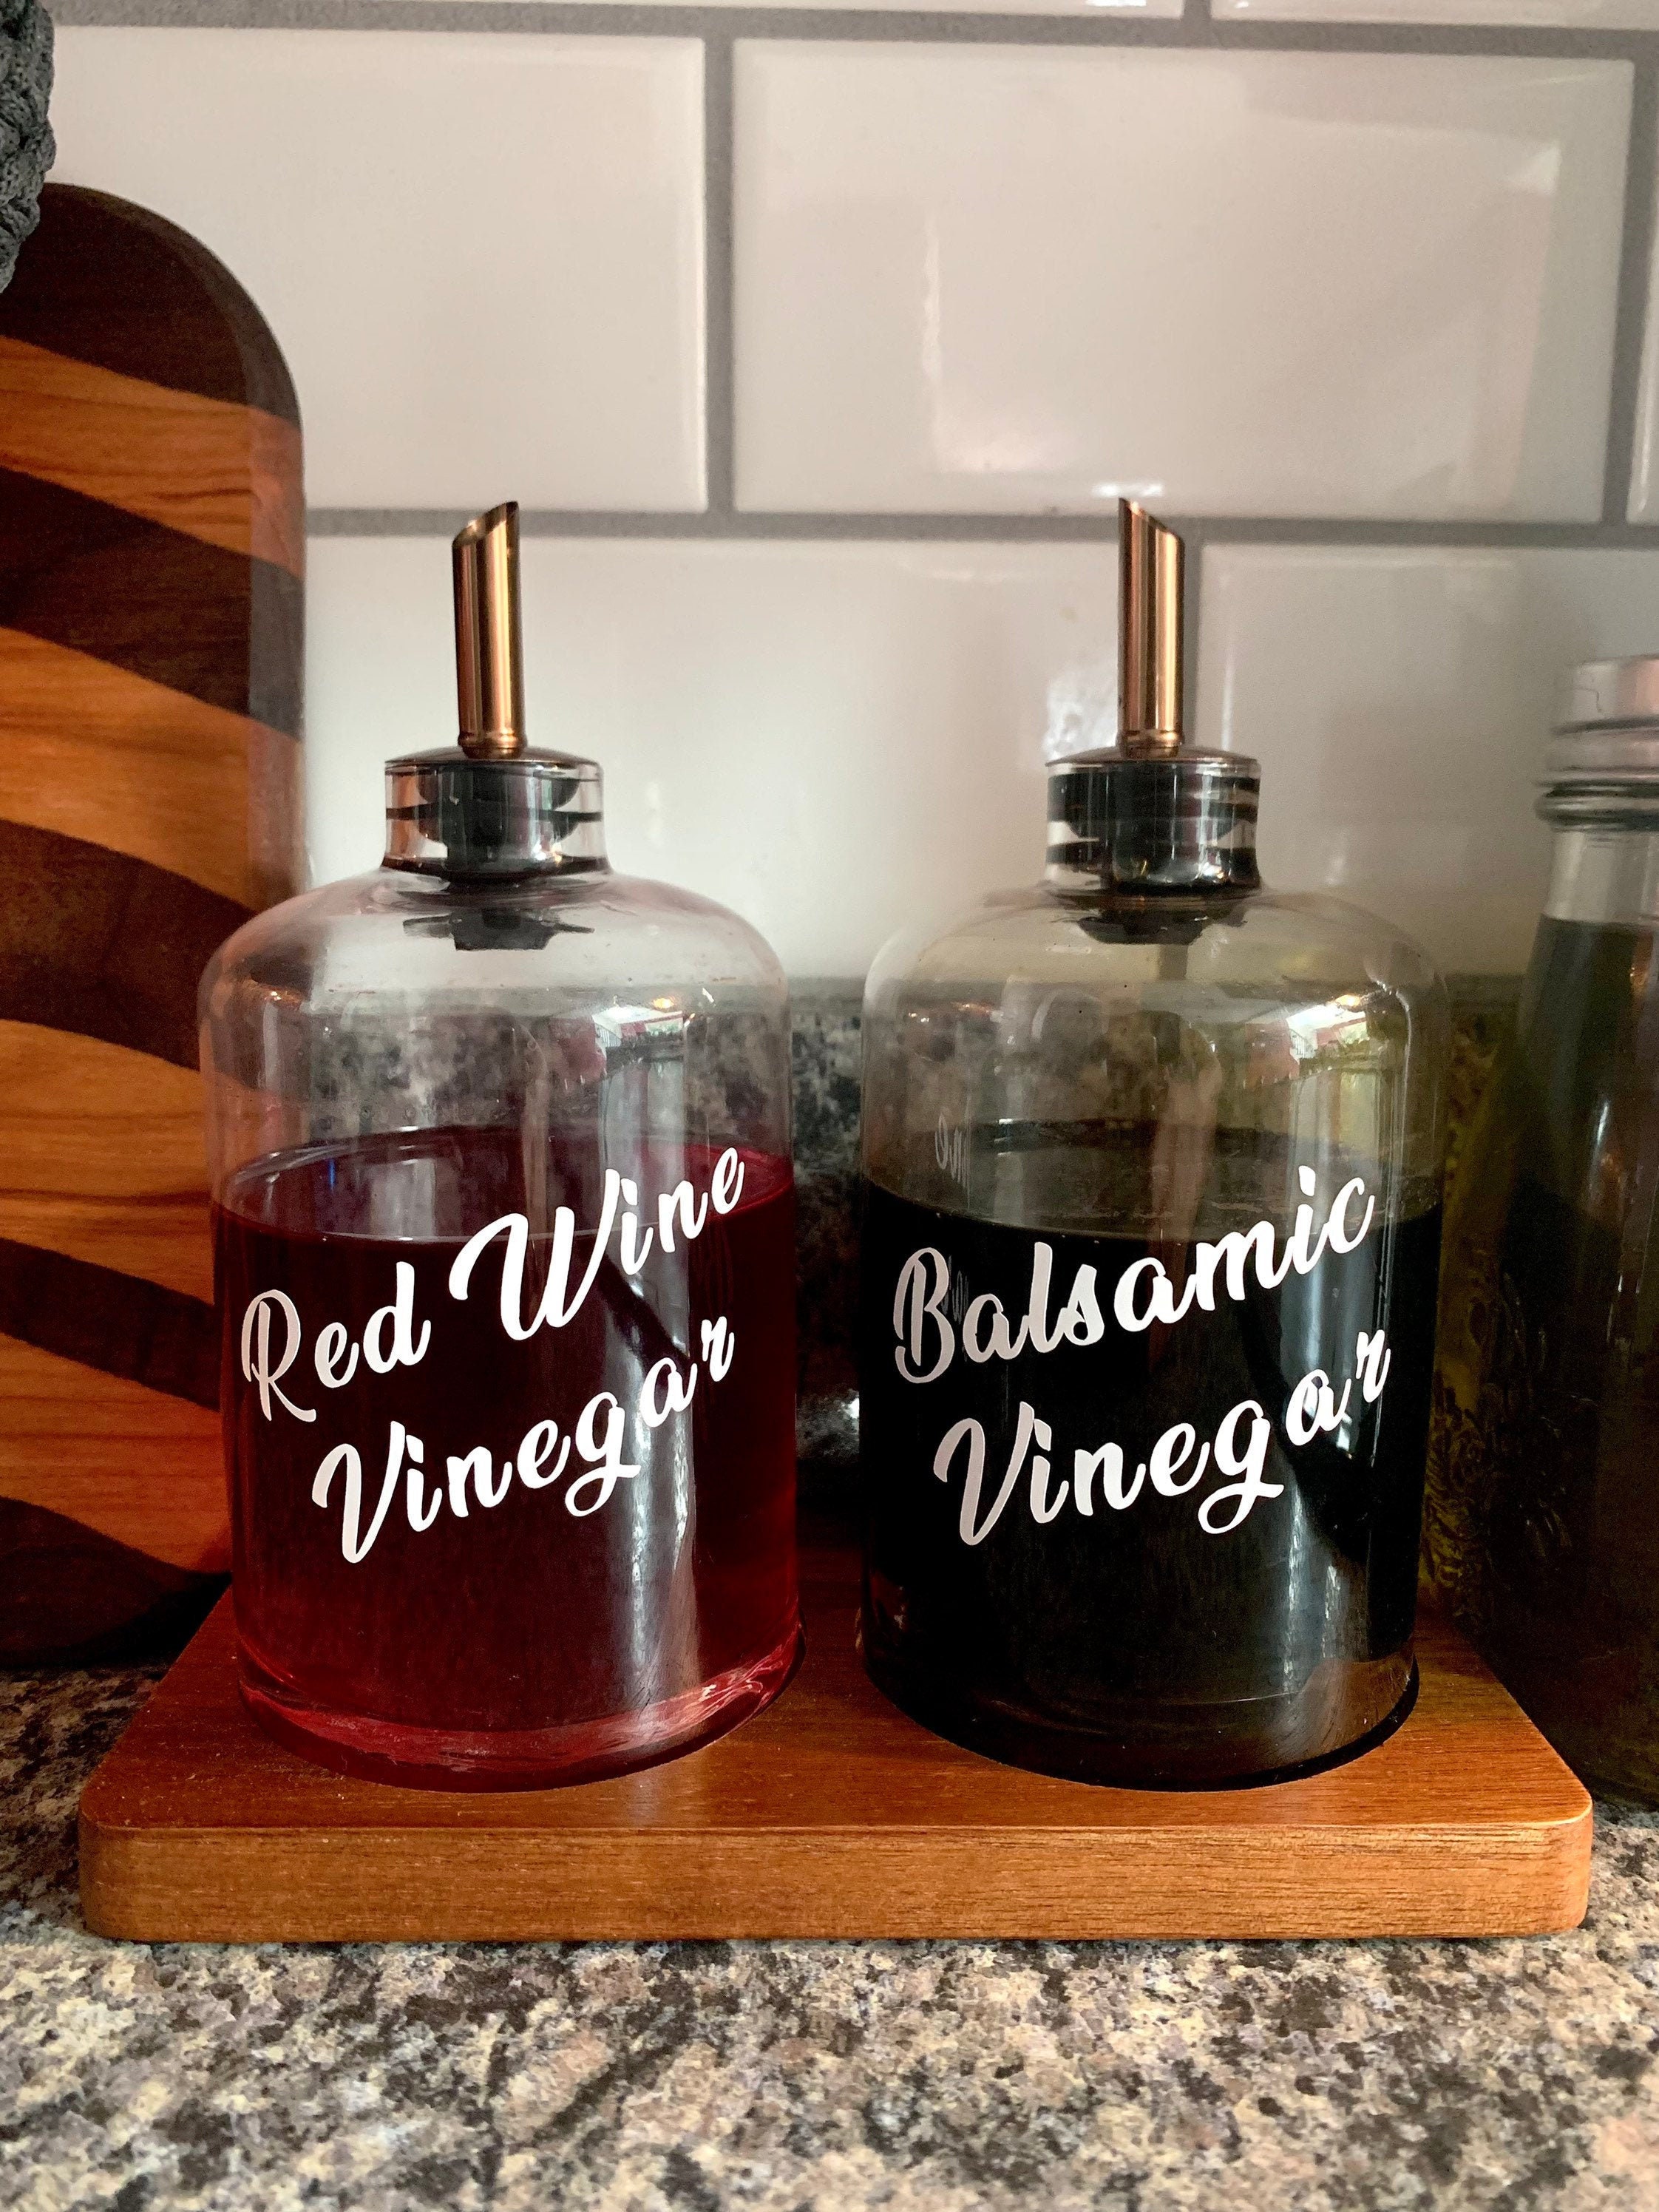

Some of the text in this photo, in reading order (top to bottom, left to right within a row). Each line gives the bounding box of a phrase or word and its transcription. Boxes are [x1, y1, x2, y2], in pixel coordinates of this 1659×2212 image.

[241, 1261, 432, 1422] Red
[448, 1147, 746, 1341] Wine
[893, 1165, 1376, 1384] Balsamic
[311, 1316, 736, 1564] Vinegar
[933, 1329, 1391, 1546] Vinegar
